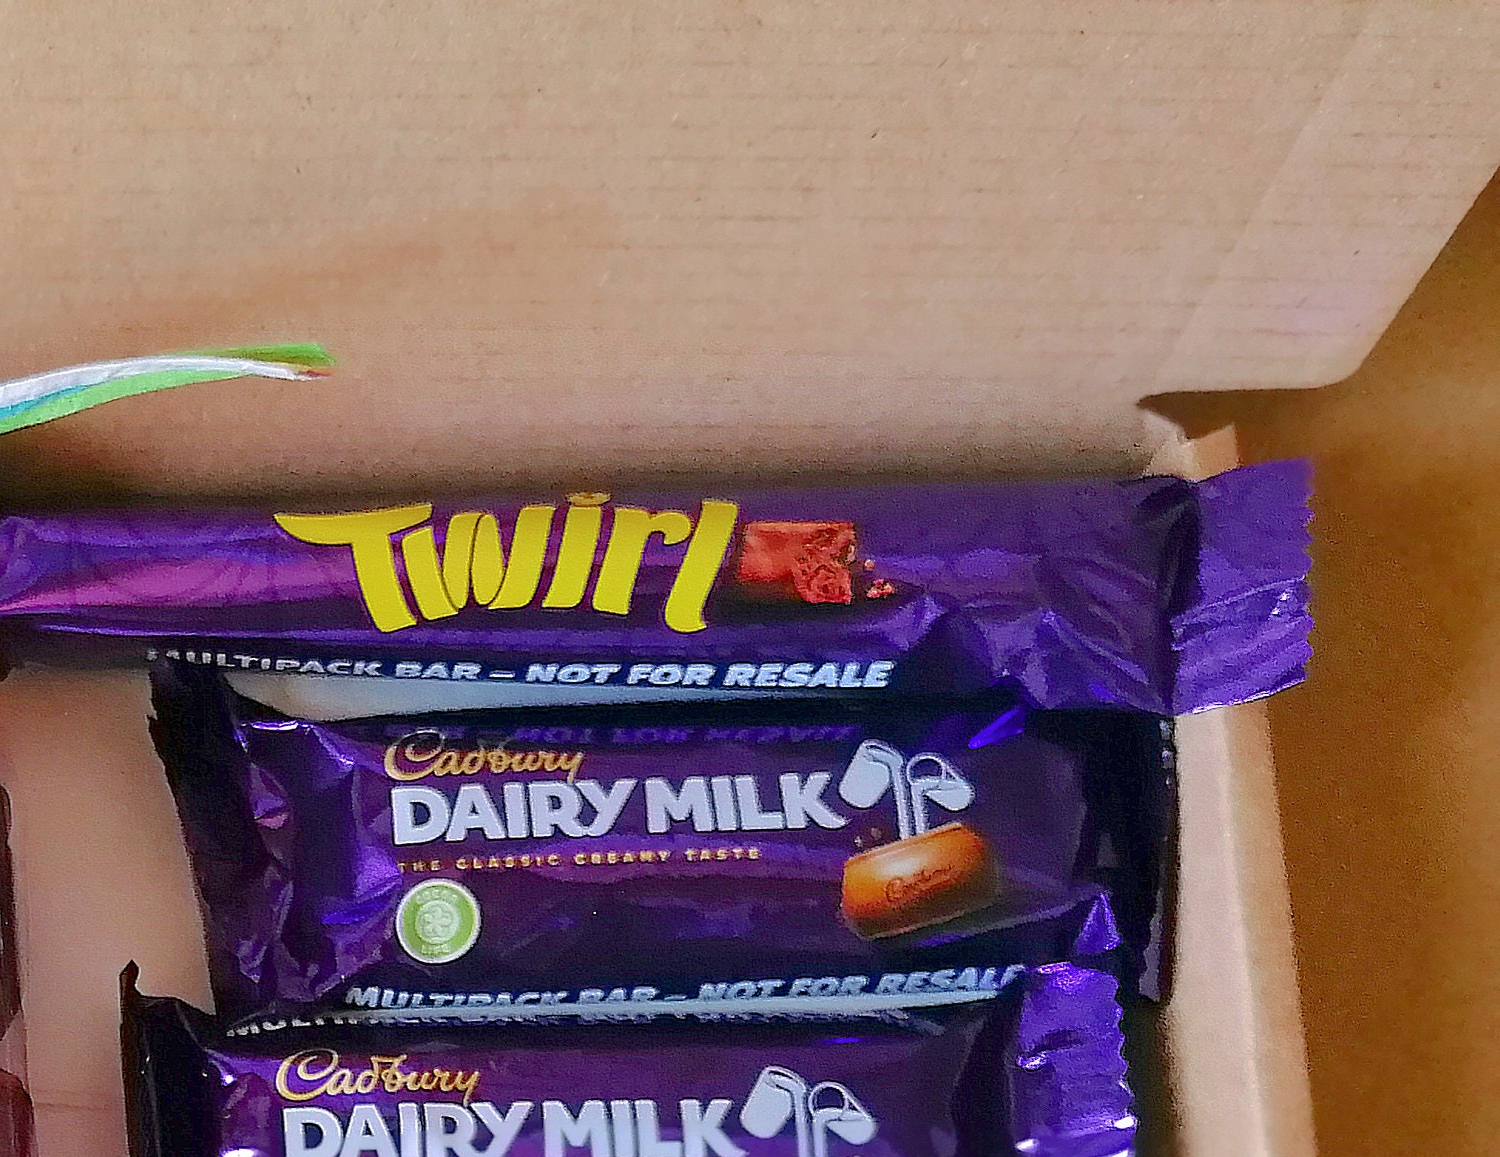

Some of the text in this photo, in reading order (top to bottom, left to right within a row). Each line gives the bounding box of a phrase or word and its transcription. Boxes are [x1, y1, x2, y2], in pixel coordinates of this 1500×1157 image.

[273, 492, 737, 633] Twirl
[147, 649, 382, 677] MULTIPACK
[396, 661, 481, 680] BAR
[525, 662, 621, 684] NOT
[627, 663, 717, 686] FOR
[722, 659, 895, 687] RESALE
[384, 730, 584, 783] Cadbury
[391, 772, 850, 845] DAIRY MILK
[397, 848, 762, 873] THE CLASSIC CREAMY TASTE
[345, 985, 570, 1008] MULTIPACK
[700, 979, 785, 999] NOT
[789, 975, 869, 998] FOR
[276, 1049, 481, 1105] Cadbury
